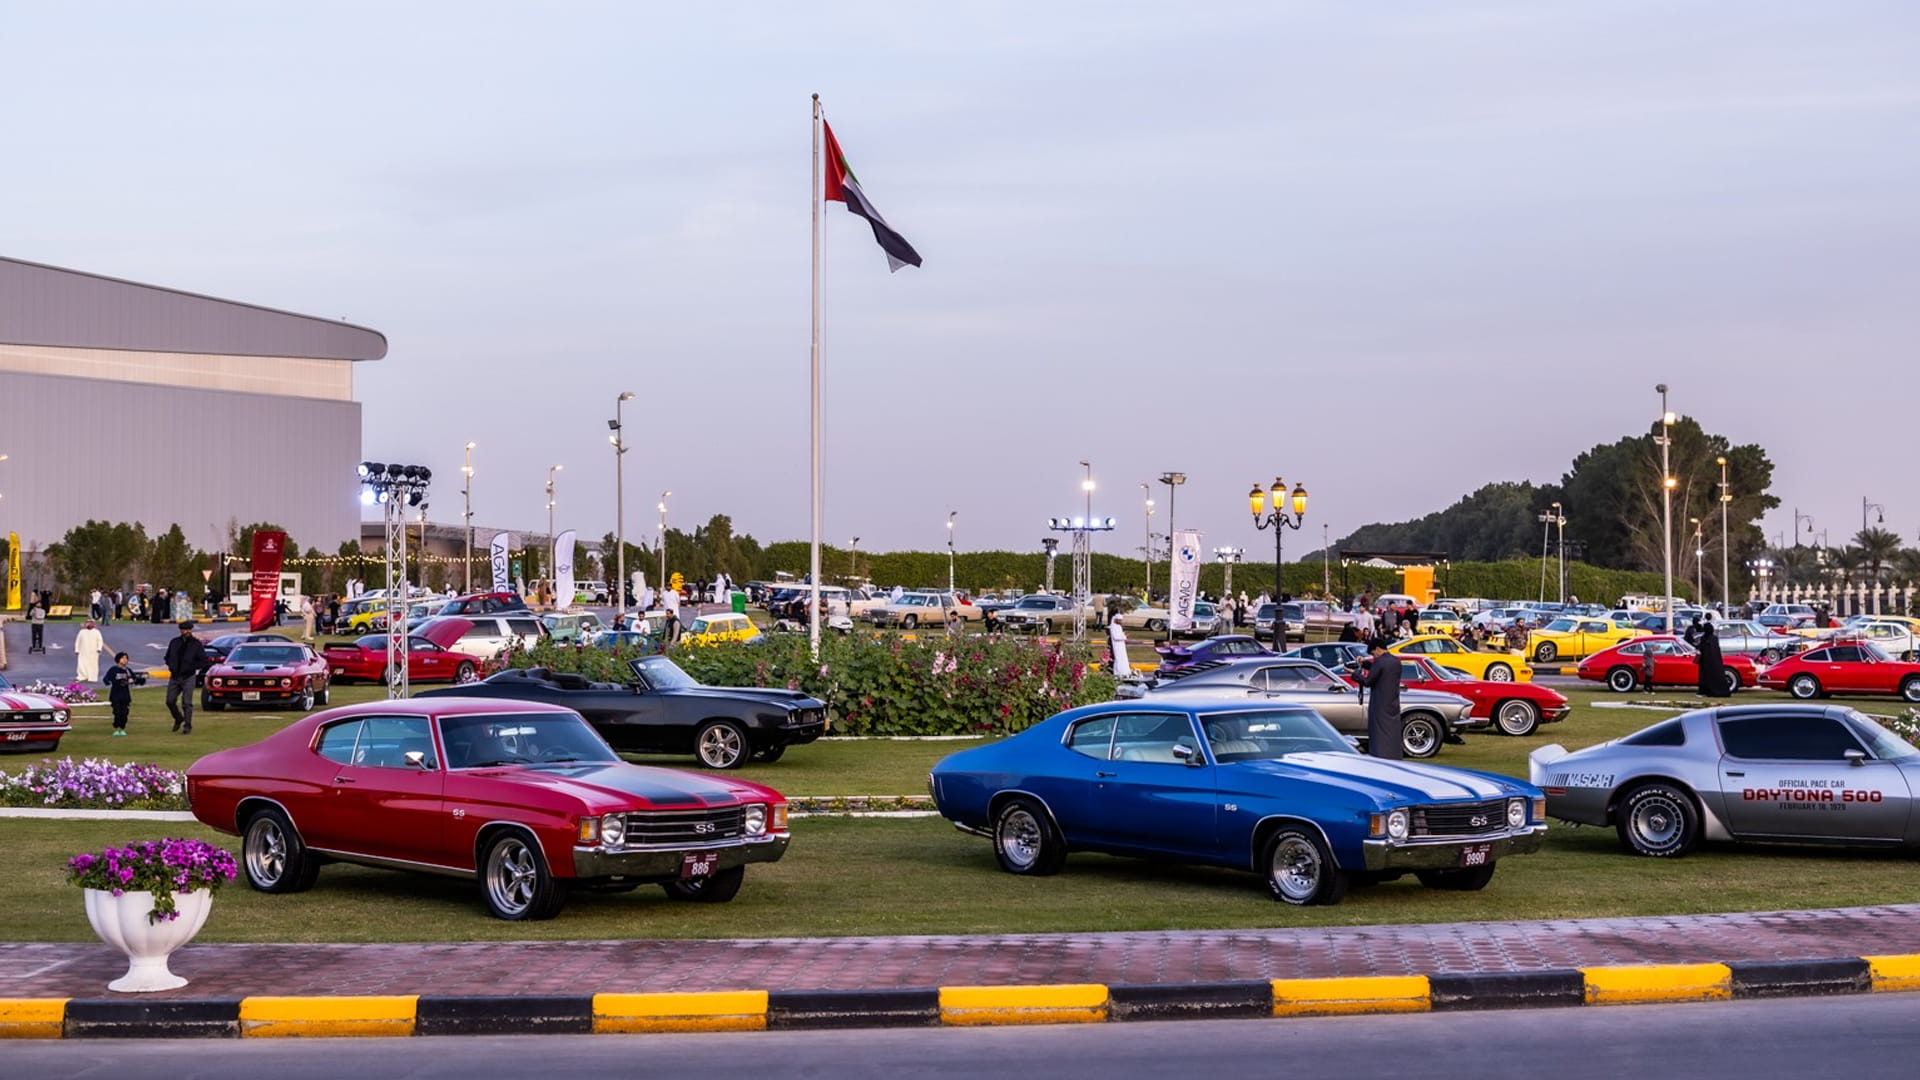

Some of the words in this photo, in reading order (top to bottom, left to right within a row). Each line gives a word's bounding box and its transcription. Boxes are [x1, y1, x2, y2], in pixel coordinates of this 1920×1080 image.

[1177, 580, 1191, 618] AGMC
[1567, 773, 1612, 788] NASCAR
[1778, 779, 1809, 788] OFFICIAL
[1811, 779, 1827, 788] PACE
[1830, 780, 1845, 788] CAR
[1743, 788, 1834, 801] DAYTONA
[1842, 790, 1883, 803] 500
[1779, 802, 1816, 811] FEBRUARY
[1830, 802, 1847, 811] 1979
[1471, 815, 1488, 827] SS
[695, 823, 715, 834] SS
[1465, 852, 1486, 866] 9990
[691, 862, 710, 875] 886
